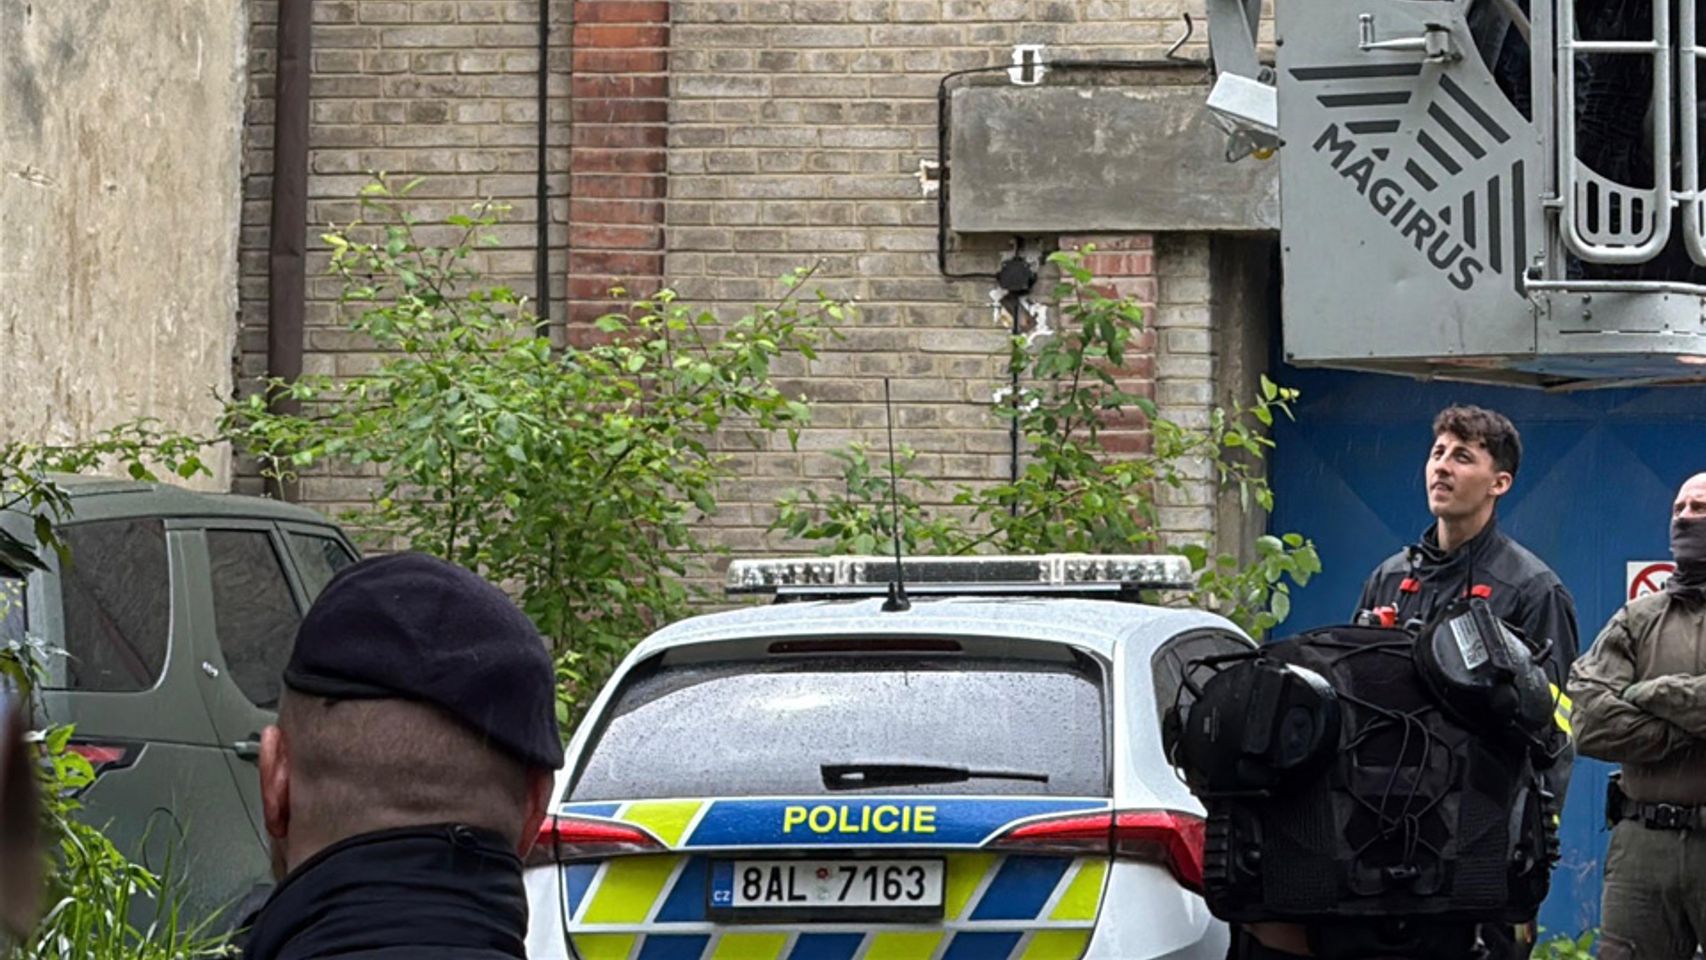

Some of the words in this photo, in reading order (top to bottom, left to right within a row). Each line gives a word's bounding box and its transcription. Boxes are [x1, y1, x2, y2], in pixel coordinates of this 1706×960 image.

[1312, 123, 1484, 291] MAGIRUS
[783, 805, 937, 833] POLICIE
[713, 891, 731, 902] CZ
[742, 866, 806, 901] 8AL
[838, 866, 926, 901] 7163
